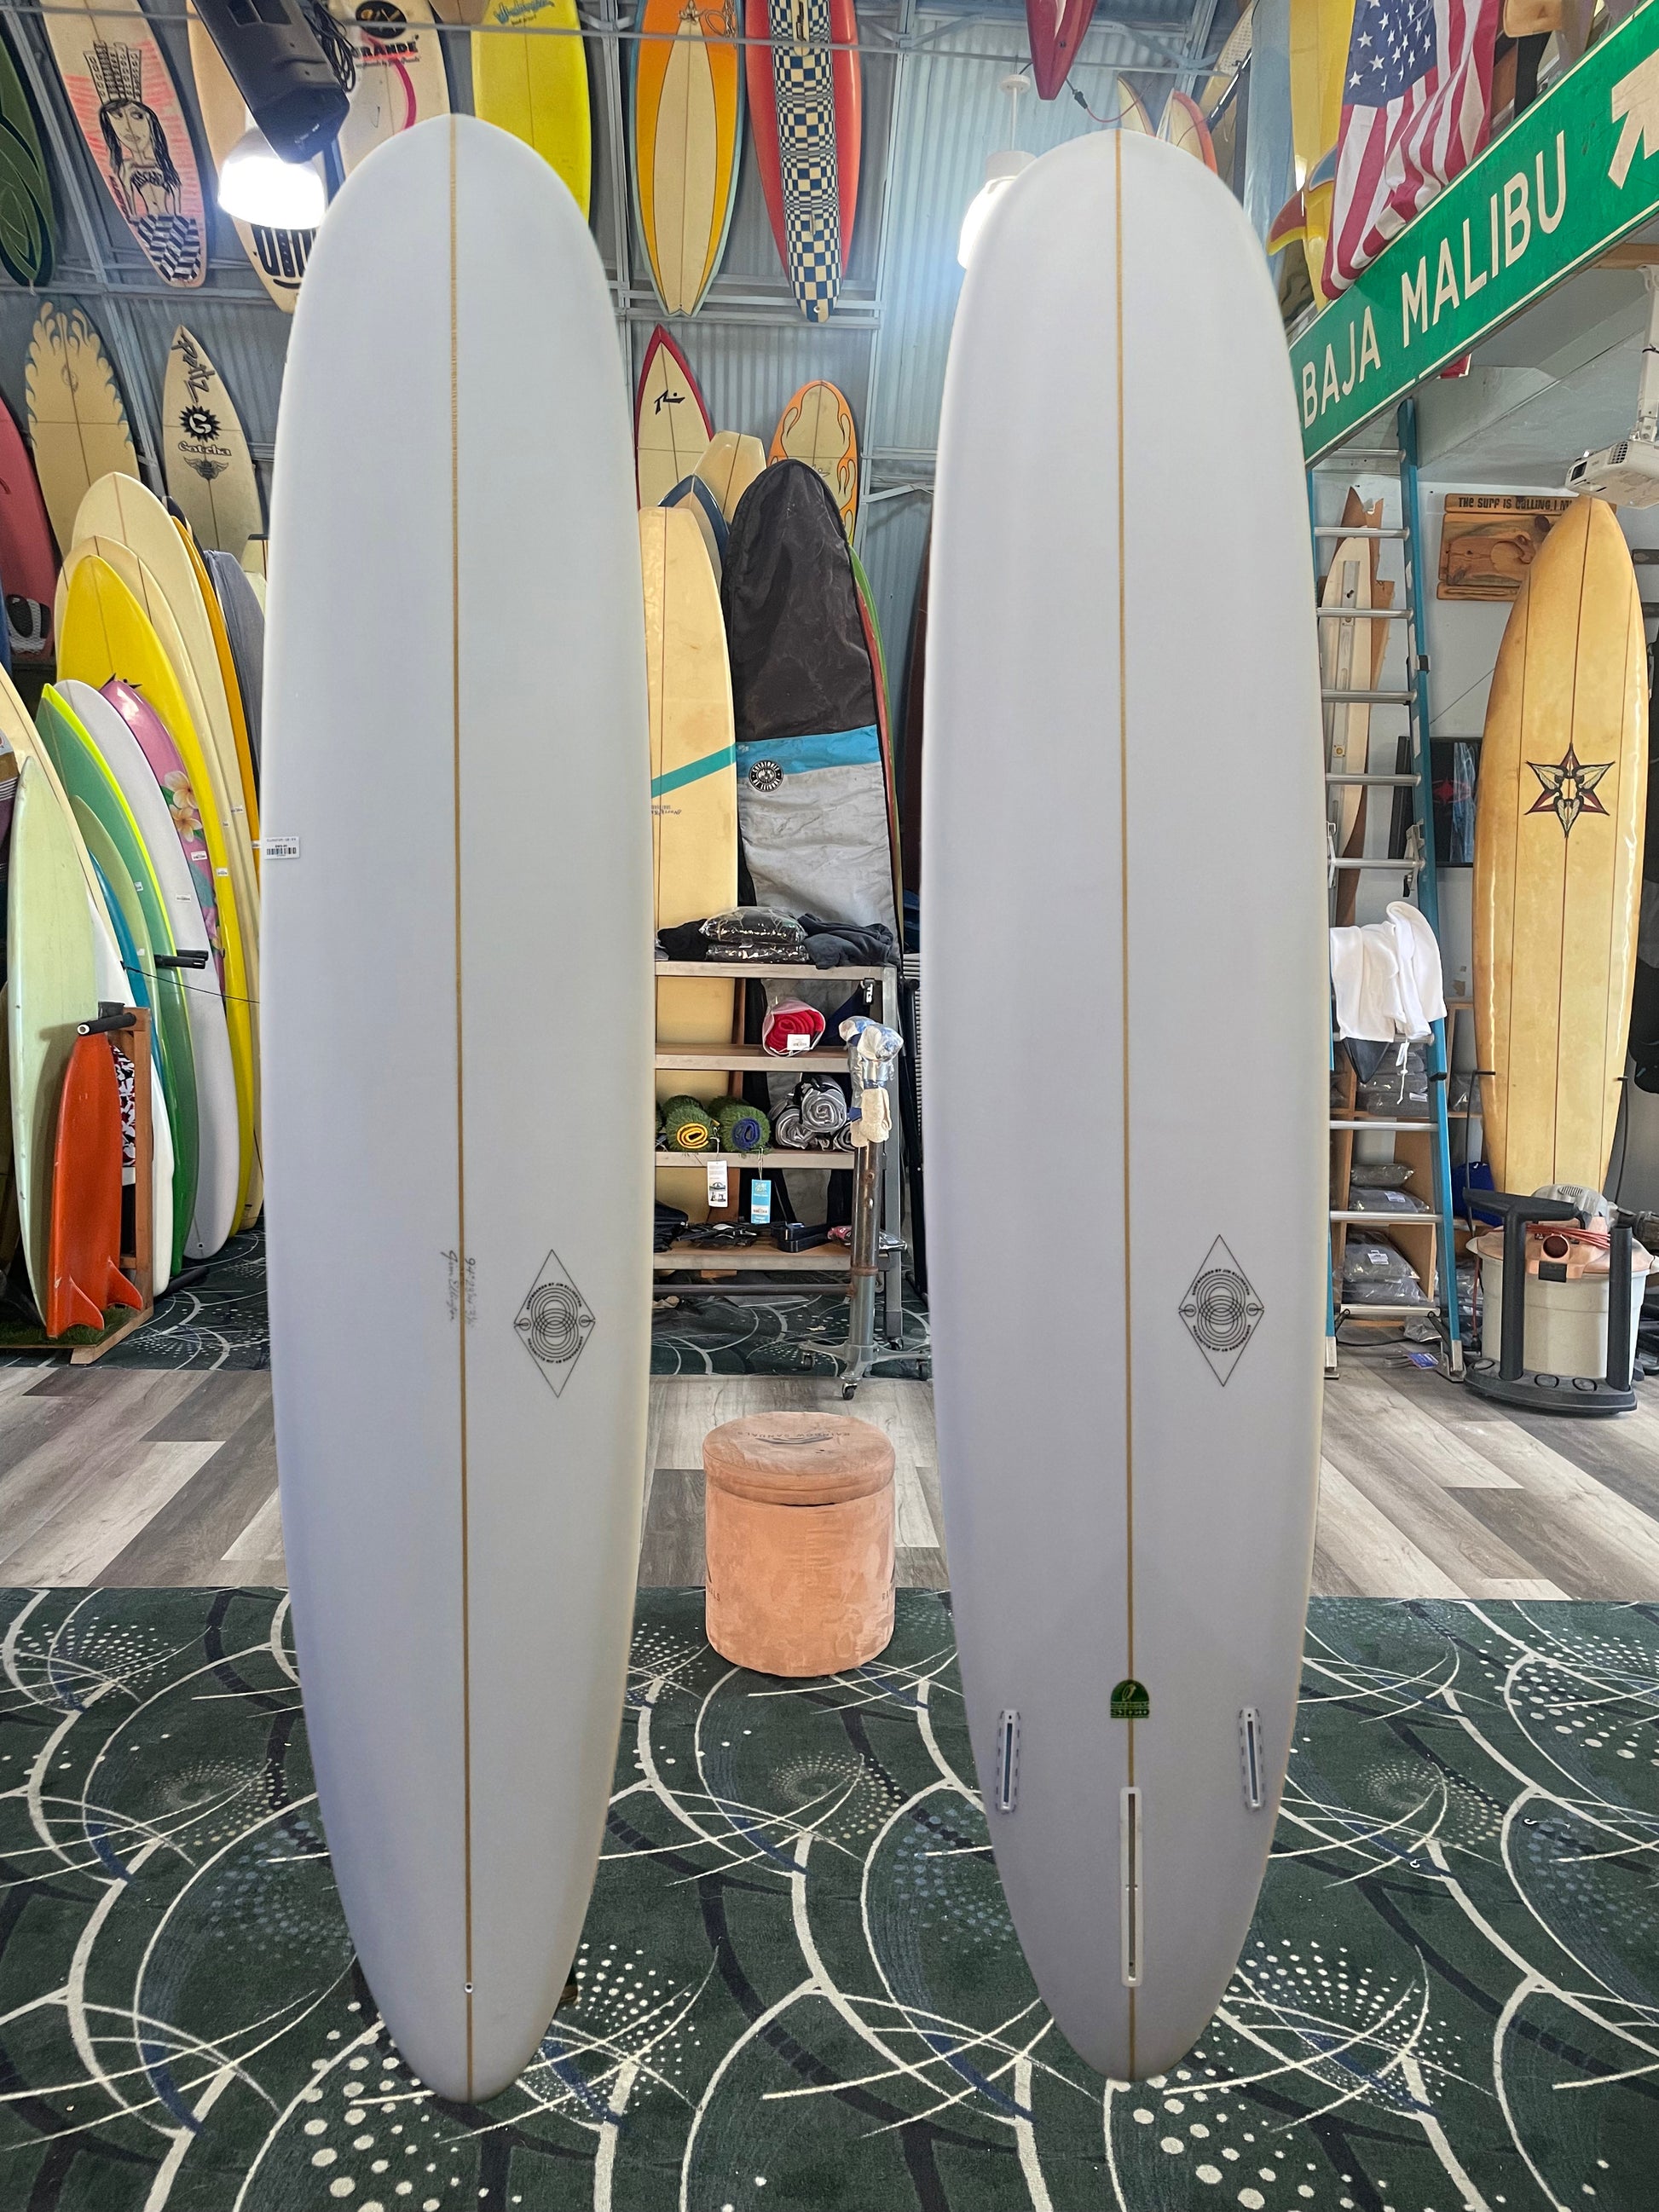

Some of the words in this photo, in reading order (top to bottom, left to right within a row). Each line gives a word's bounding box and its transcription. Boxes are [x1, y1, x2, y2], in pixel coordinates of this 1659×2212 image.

[1302, 305, 1381, 429] BAJA
[1401, 130, 1567, 348] MALIBU
[177, 440, 232, 456] Gotcha
